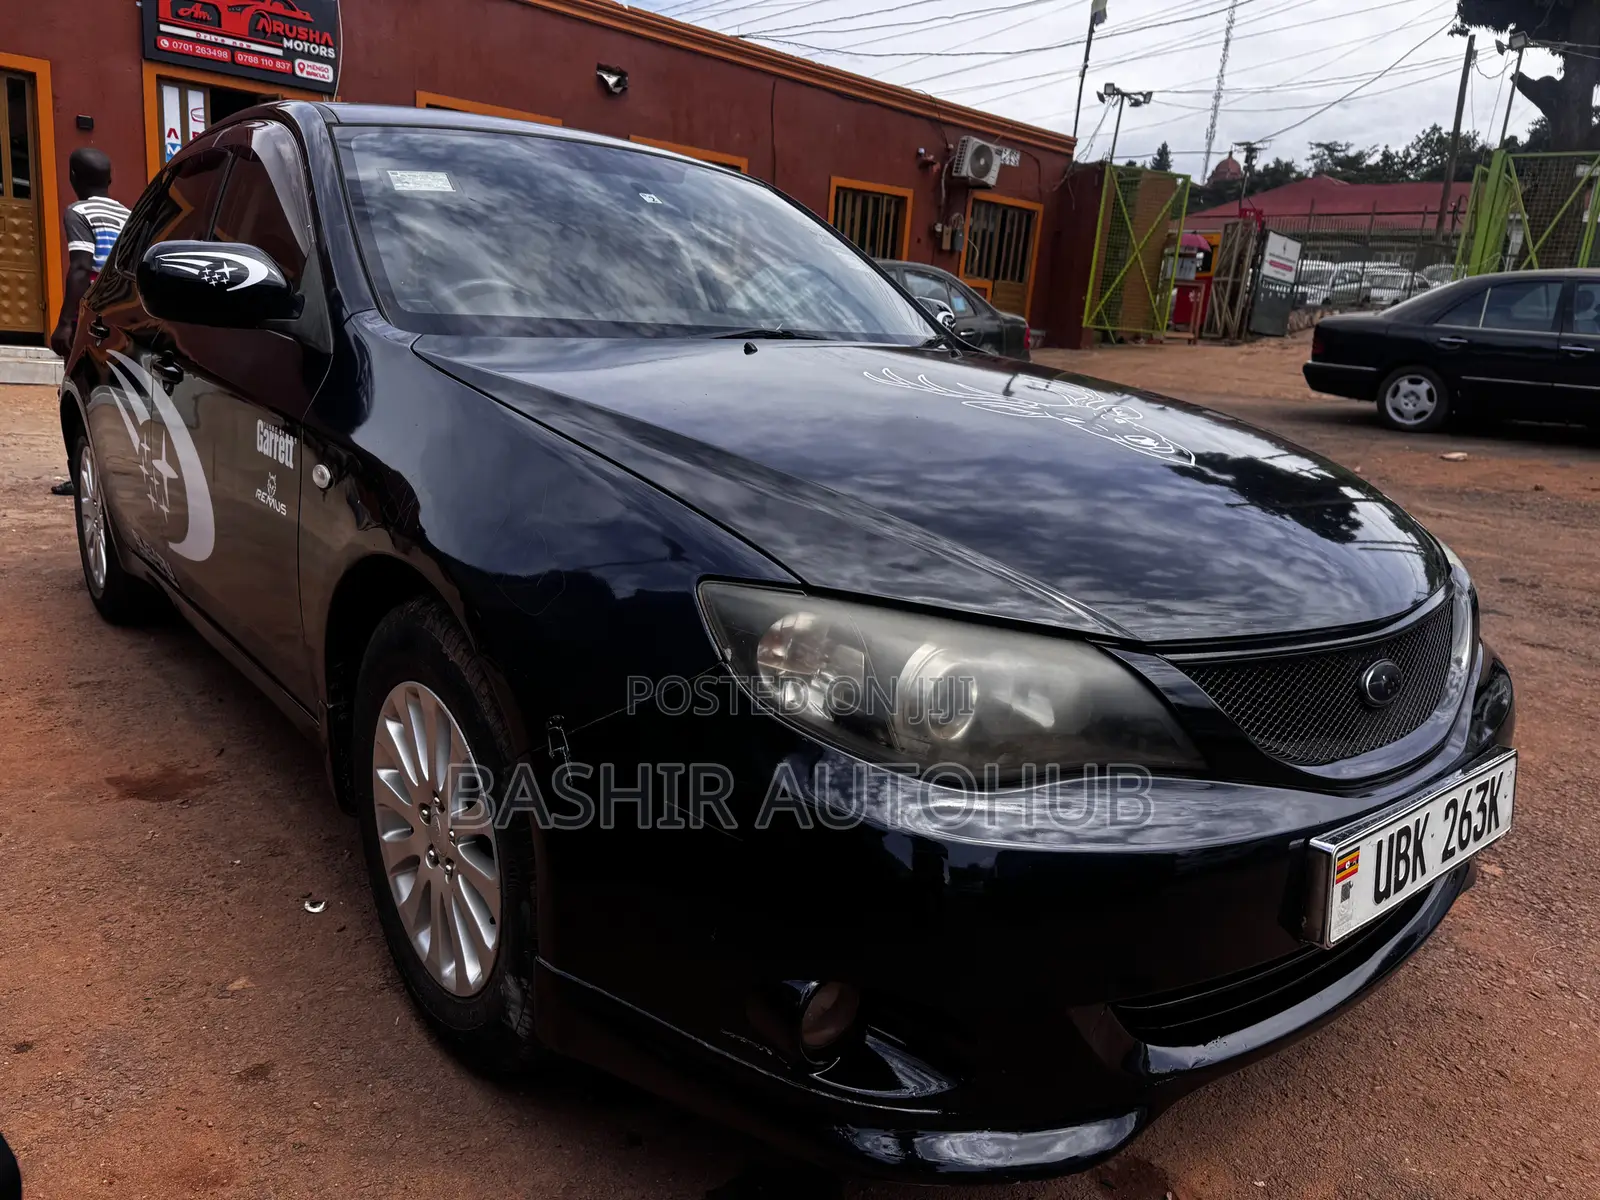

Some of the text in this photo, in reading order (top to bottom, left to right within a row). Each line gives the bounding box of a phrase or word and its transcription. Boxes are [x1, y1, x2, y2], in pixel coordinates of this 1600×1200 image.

[196, 32, 252, 49] Drive now
[256, 17, 334, 47] ARUSHA
[172, 41, 228, 59] 0701 263498
[283, 37, 336, 59] MOTORS
[237, 53, 291, 70] 0788 110 837
[306, 63, 330, 73] MENGO
[256, 418, 295, 470] Garrett
[255, 488, 287, 516] REMUS
[1373, 771, 1504, 905] UBK 263K
